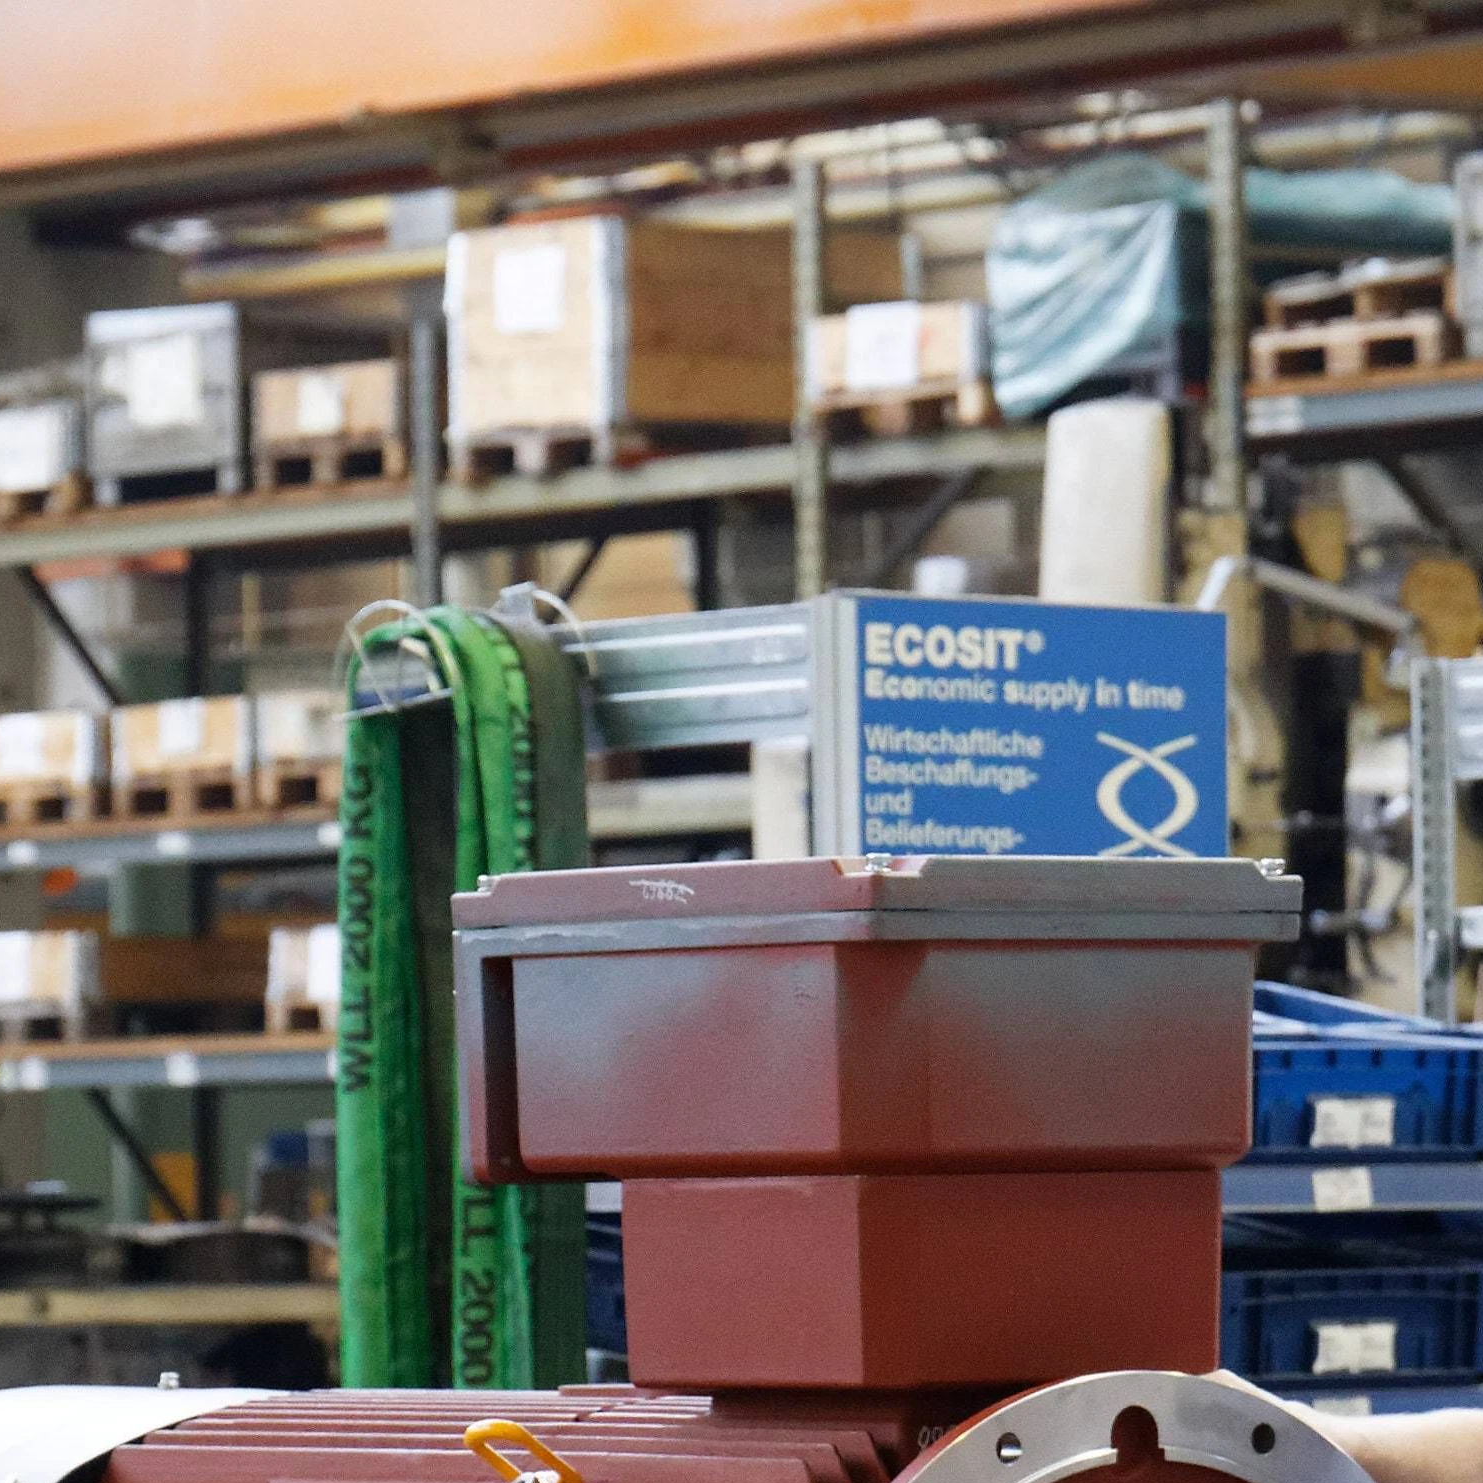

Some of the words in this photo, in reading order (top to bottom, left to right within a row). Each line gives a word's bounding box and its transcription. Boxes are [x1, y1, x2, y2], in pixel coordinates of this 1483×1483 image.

[864, 670, 995, 702] Economic
[1004, 678, 1089, 711] supply
[1095, 677, 1122, 707] in
[1127, 680, 1185, 711] time
[864, 725, 1043, 757] Wirtschaftliche
[865, 758, 1037, 794] Beschaffungs-
[345, 764, 374, 841] KG
[865, 788, 911, 814] und
[865, 820, 1024, 853] Belieferungs-
[345, 856, 374, 971] 2000
[343, 986, 373, 1094] WLL
[461, 1269, 495, 1386] 2000
